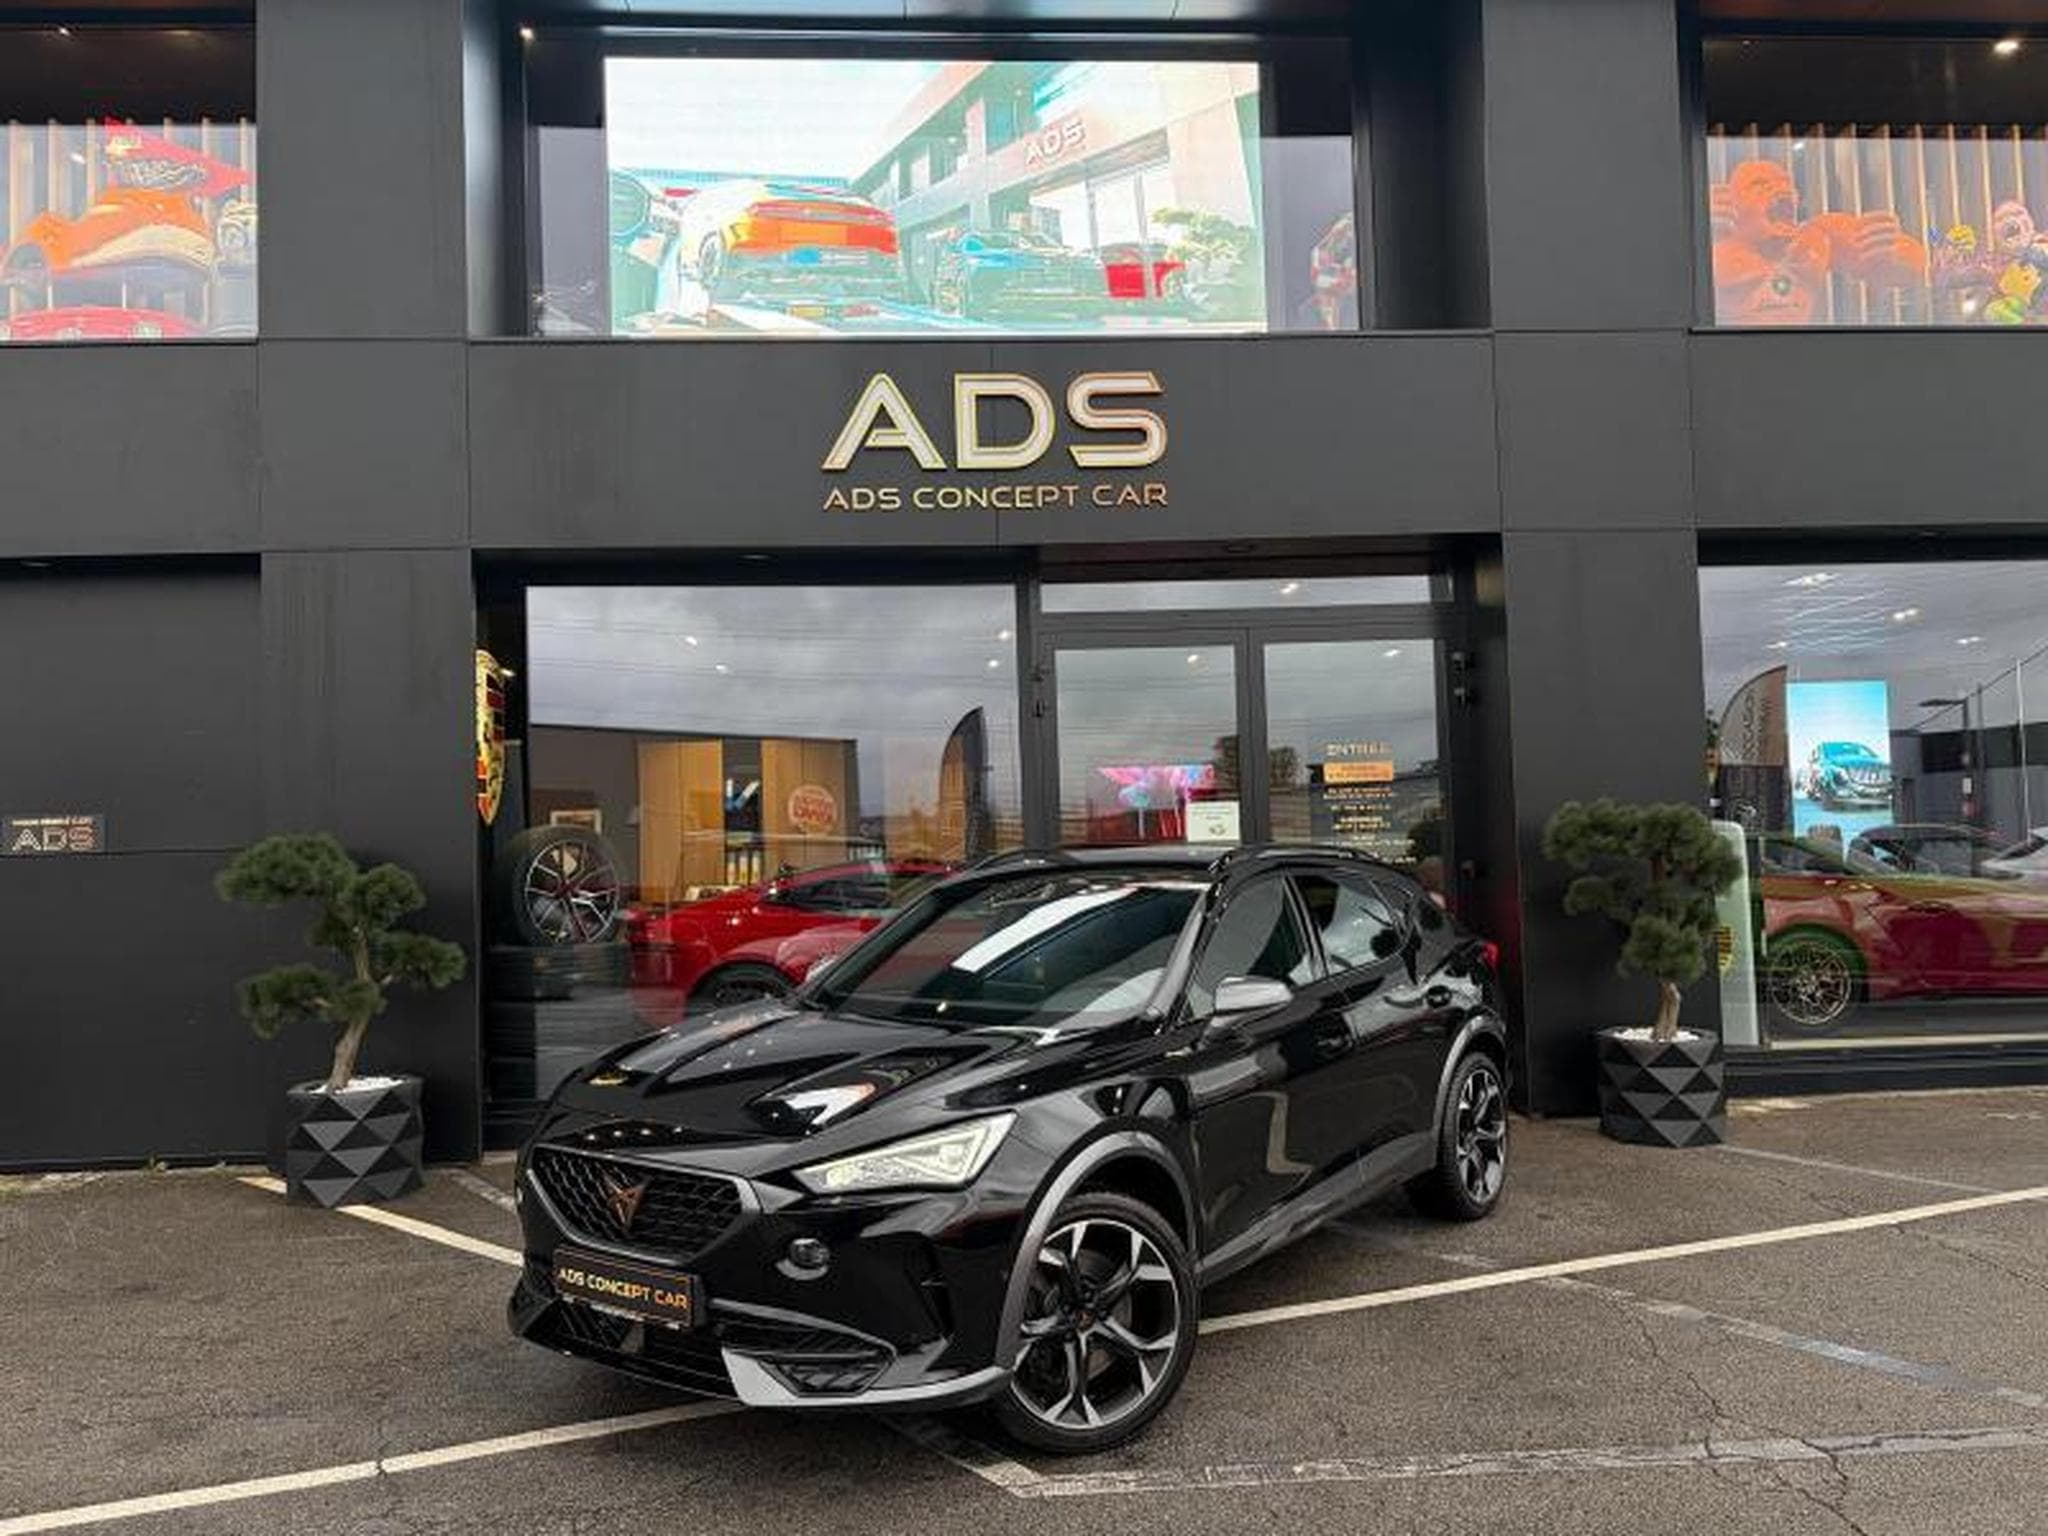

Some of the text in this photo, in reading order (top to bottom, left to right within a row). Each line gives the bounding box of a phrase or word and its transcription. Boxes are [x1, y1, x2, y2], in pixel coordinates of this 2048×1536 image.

[821, 372, 1169, 471] ADS
[822, 483, 1169, 511] ADS CONCEPT CAR
[12, 826, 95, 852] ADS
[558, 1267, 688, 1310] ADS CONCEPT CAR
